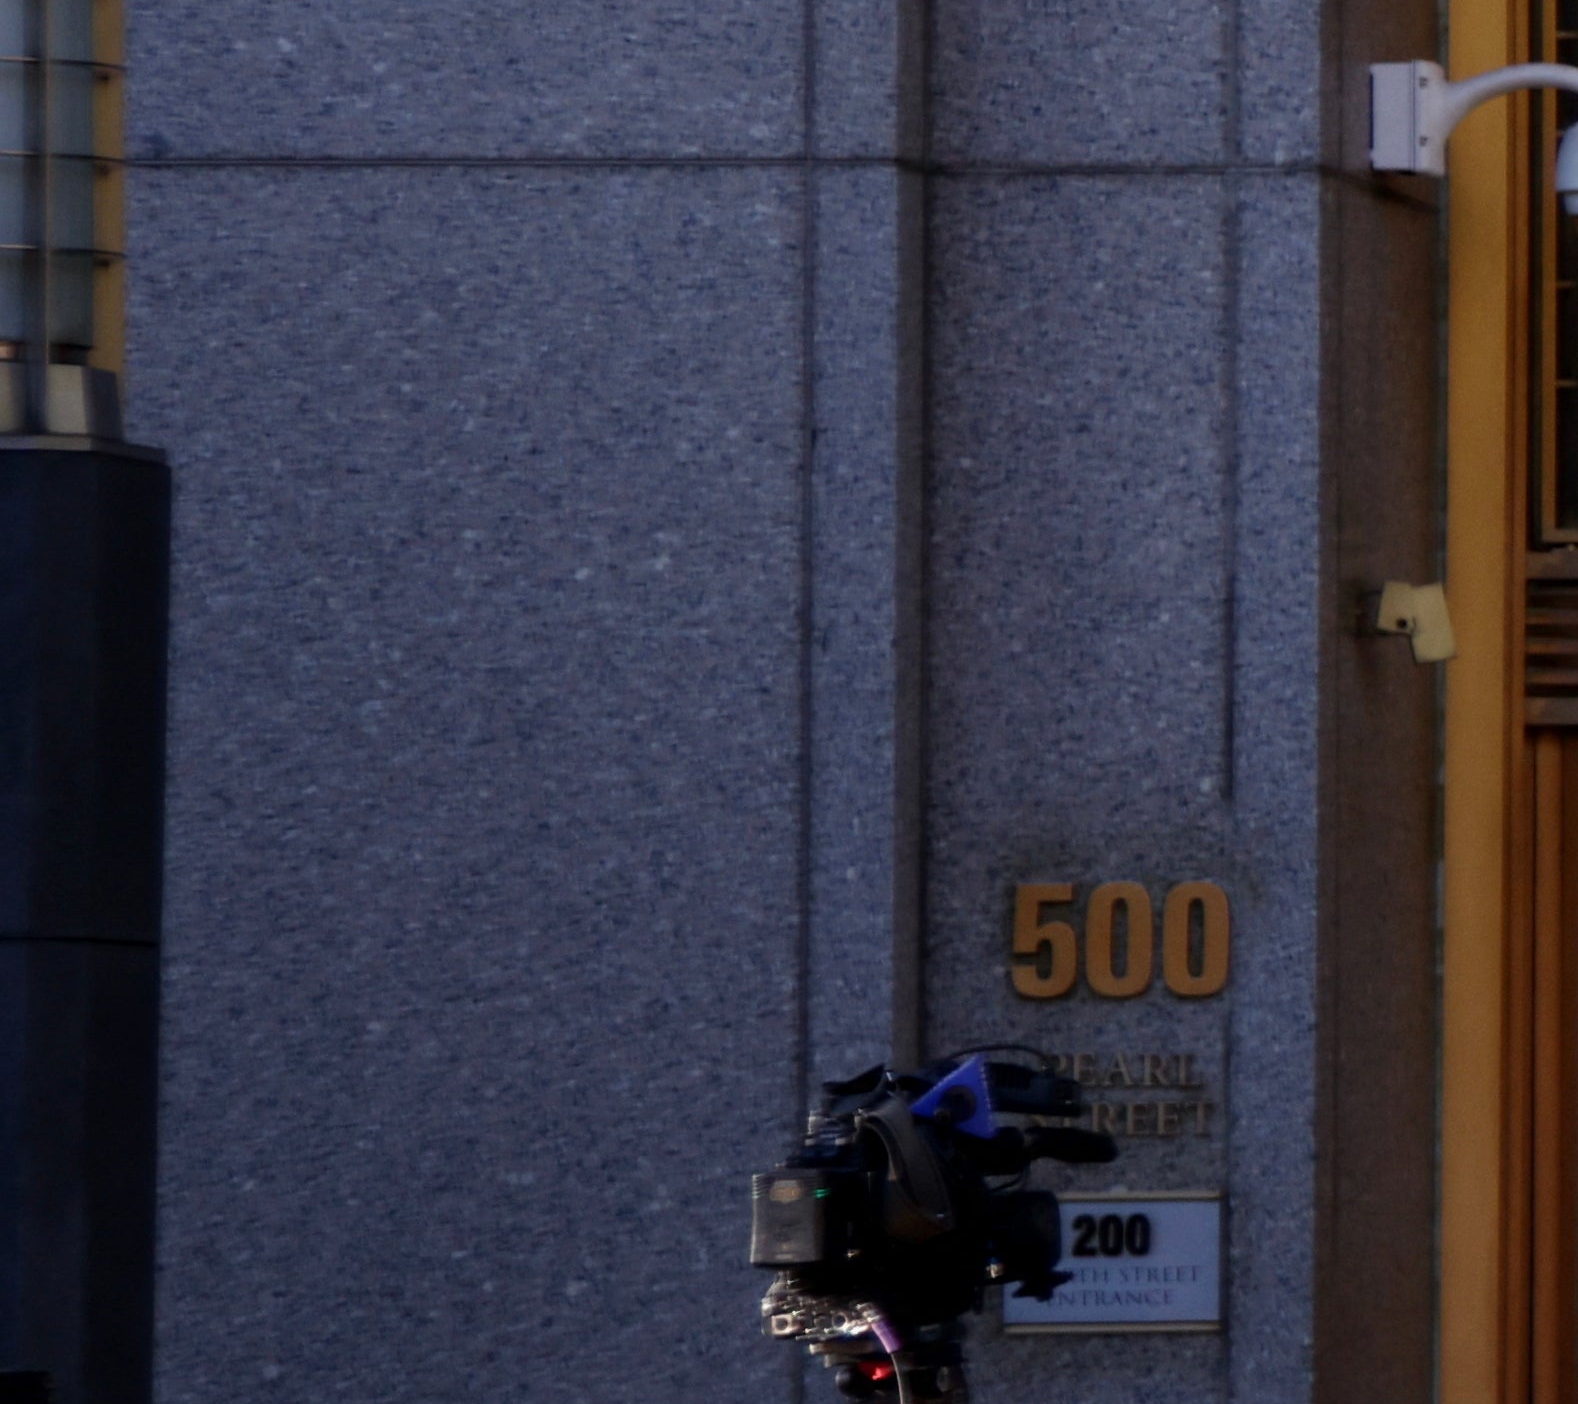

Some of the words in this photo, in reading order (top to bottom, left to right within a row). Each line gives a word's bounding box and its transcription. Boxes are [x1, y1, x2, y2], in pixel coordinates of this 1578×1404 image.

[1011, 880, 1232, 999] 500
[1072, 1213, 1151, 1257] 200
[1121, 1265, 1204, 1283] STREET
